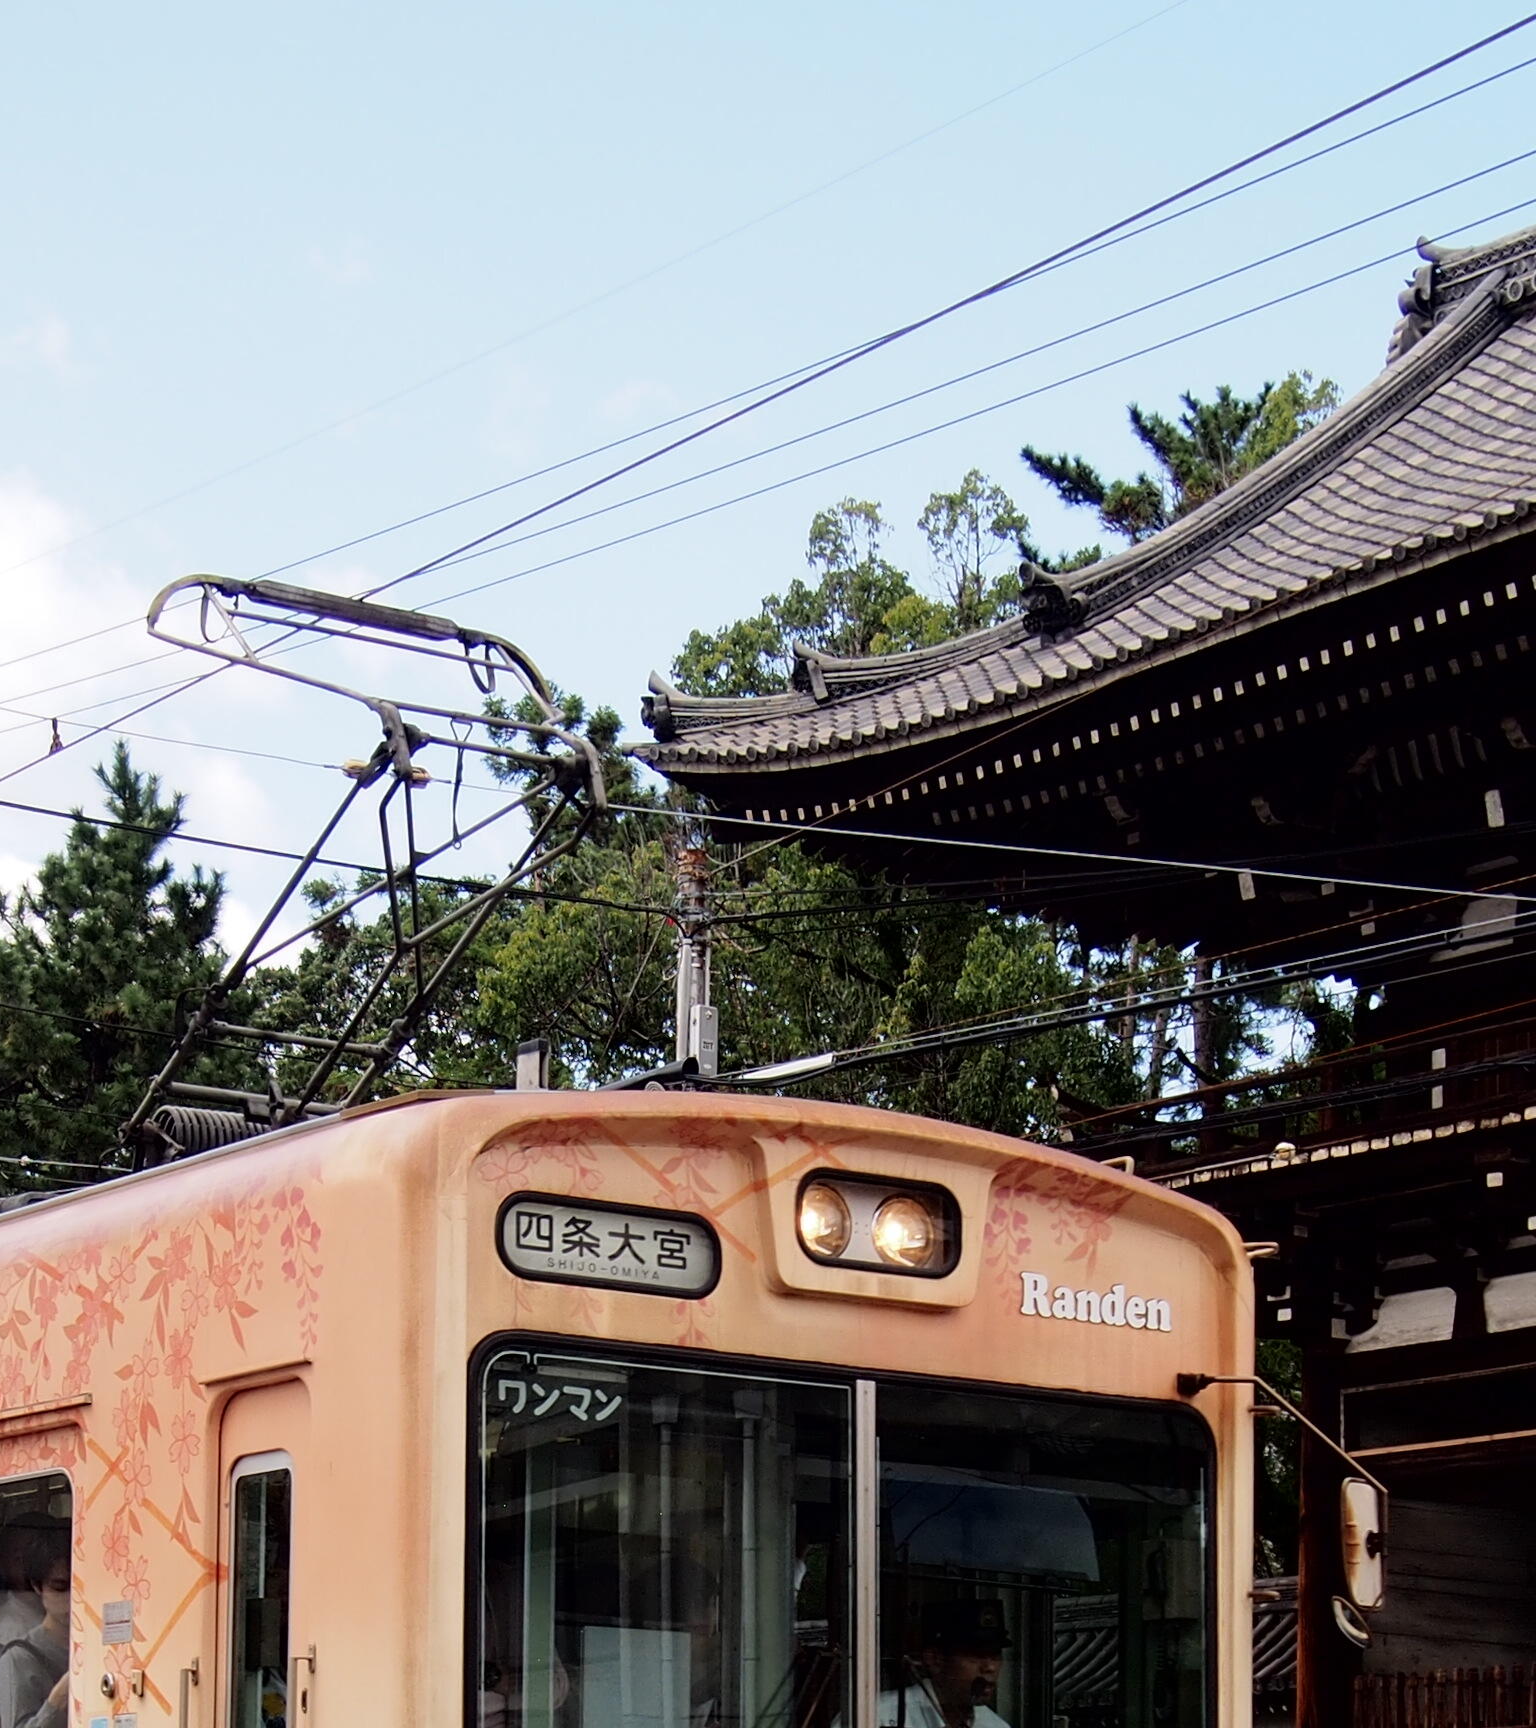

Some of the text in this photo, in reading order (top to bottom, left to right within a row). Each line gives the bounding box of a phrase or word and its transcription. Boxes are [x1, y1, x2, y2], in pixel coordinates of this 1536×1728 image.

[514, 1210, 692, 1272] 四条大宮
[546, 1256, 662, 1283] SHIJO-OMIYA
[1020, 1272, 1173, 1332] Randen
[498, 1377, 623, 1423] ワンマン
